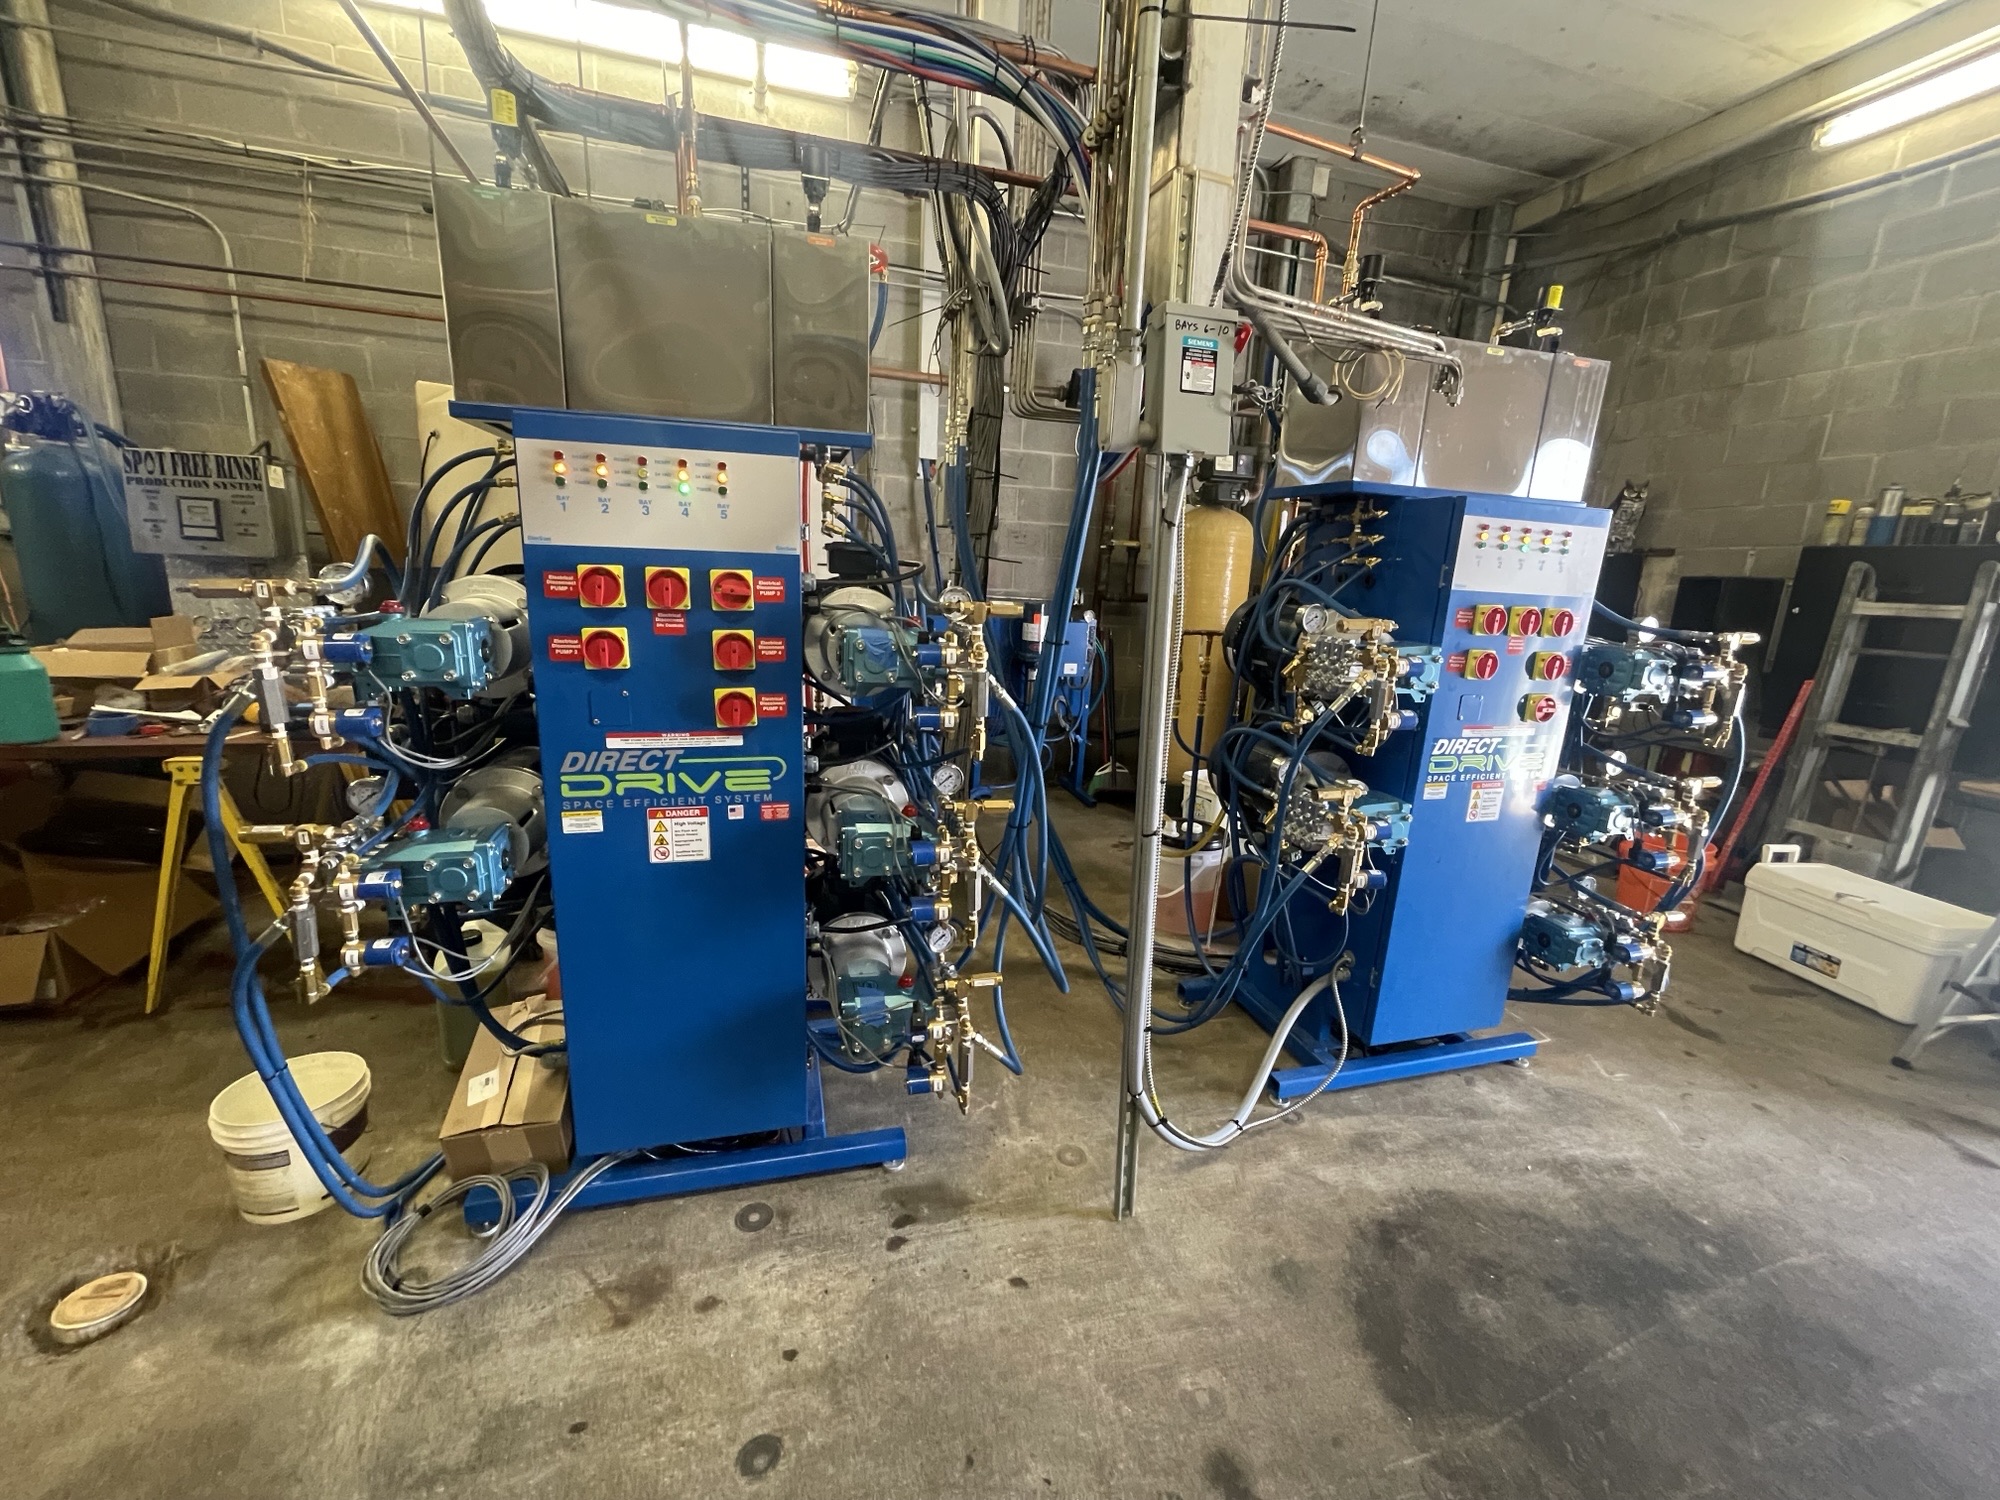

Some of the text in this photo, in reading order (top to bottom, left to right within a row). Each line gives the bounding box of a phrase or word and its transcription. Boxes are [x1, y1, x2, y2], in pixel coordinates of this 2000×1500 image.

[1176, 319, 1229, 336] BAYS 6-10
[1188, 338, 1214, 347] SIEMENS
[122, 450, 262, 481] SPOT FREE RINSE
[125, 476, 264, 492] PRODUCTION SYSTEM
[560, 503, 566, 512] 1
[601, 504, 609, 513] 2
[642, 506, 650, 516] 3
[681, 508, 690, 517] 4
[720, 510, 728, 519] 5
[1432, 738, 1502, 755] DIRECT
[561, 750, 685, 772] DIRECT
[1428, 753, 1544, 774] DRIVE
[560, 769, 771, 797] DRIVE
[1460, 772, 1506, 781] EFFICIENT
[563, 794, 773, 810] SPACE EFFICIENT SYSTEM
